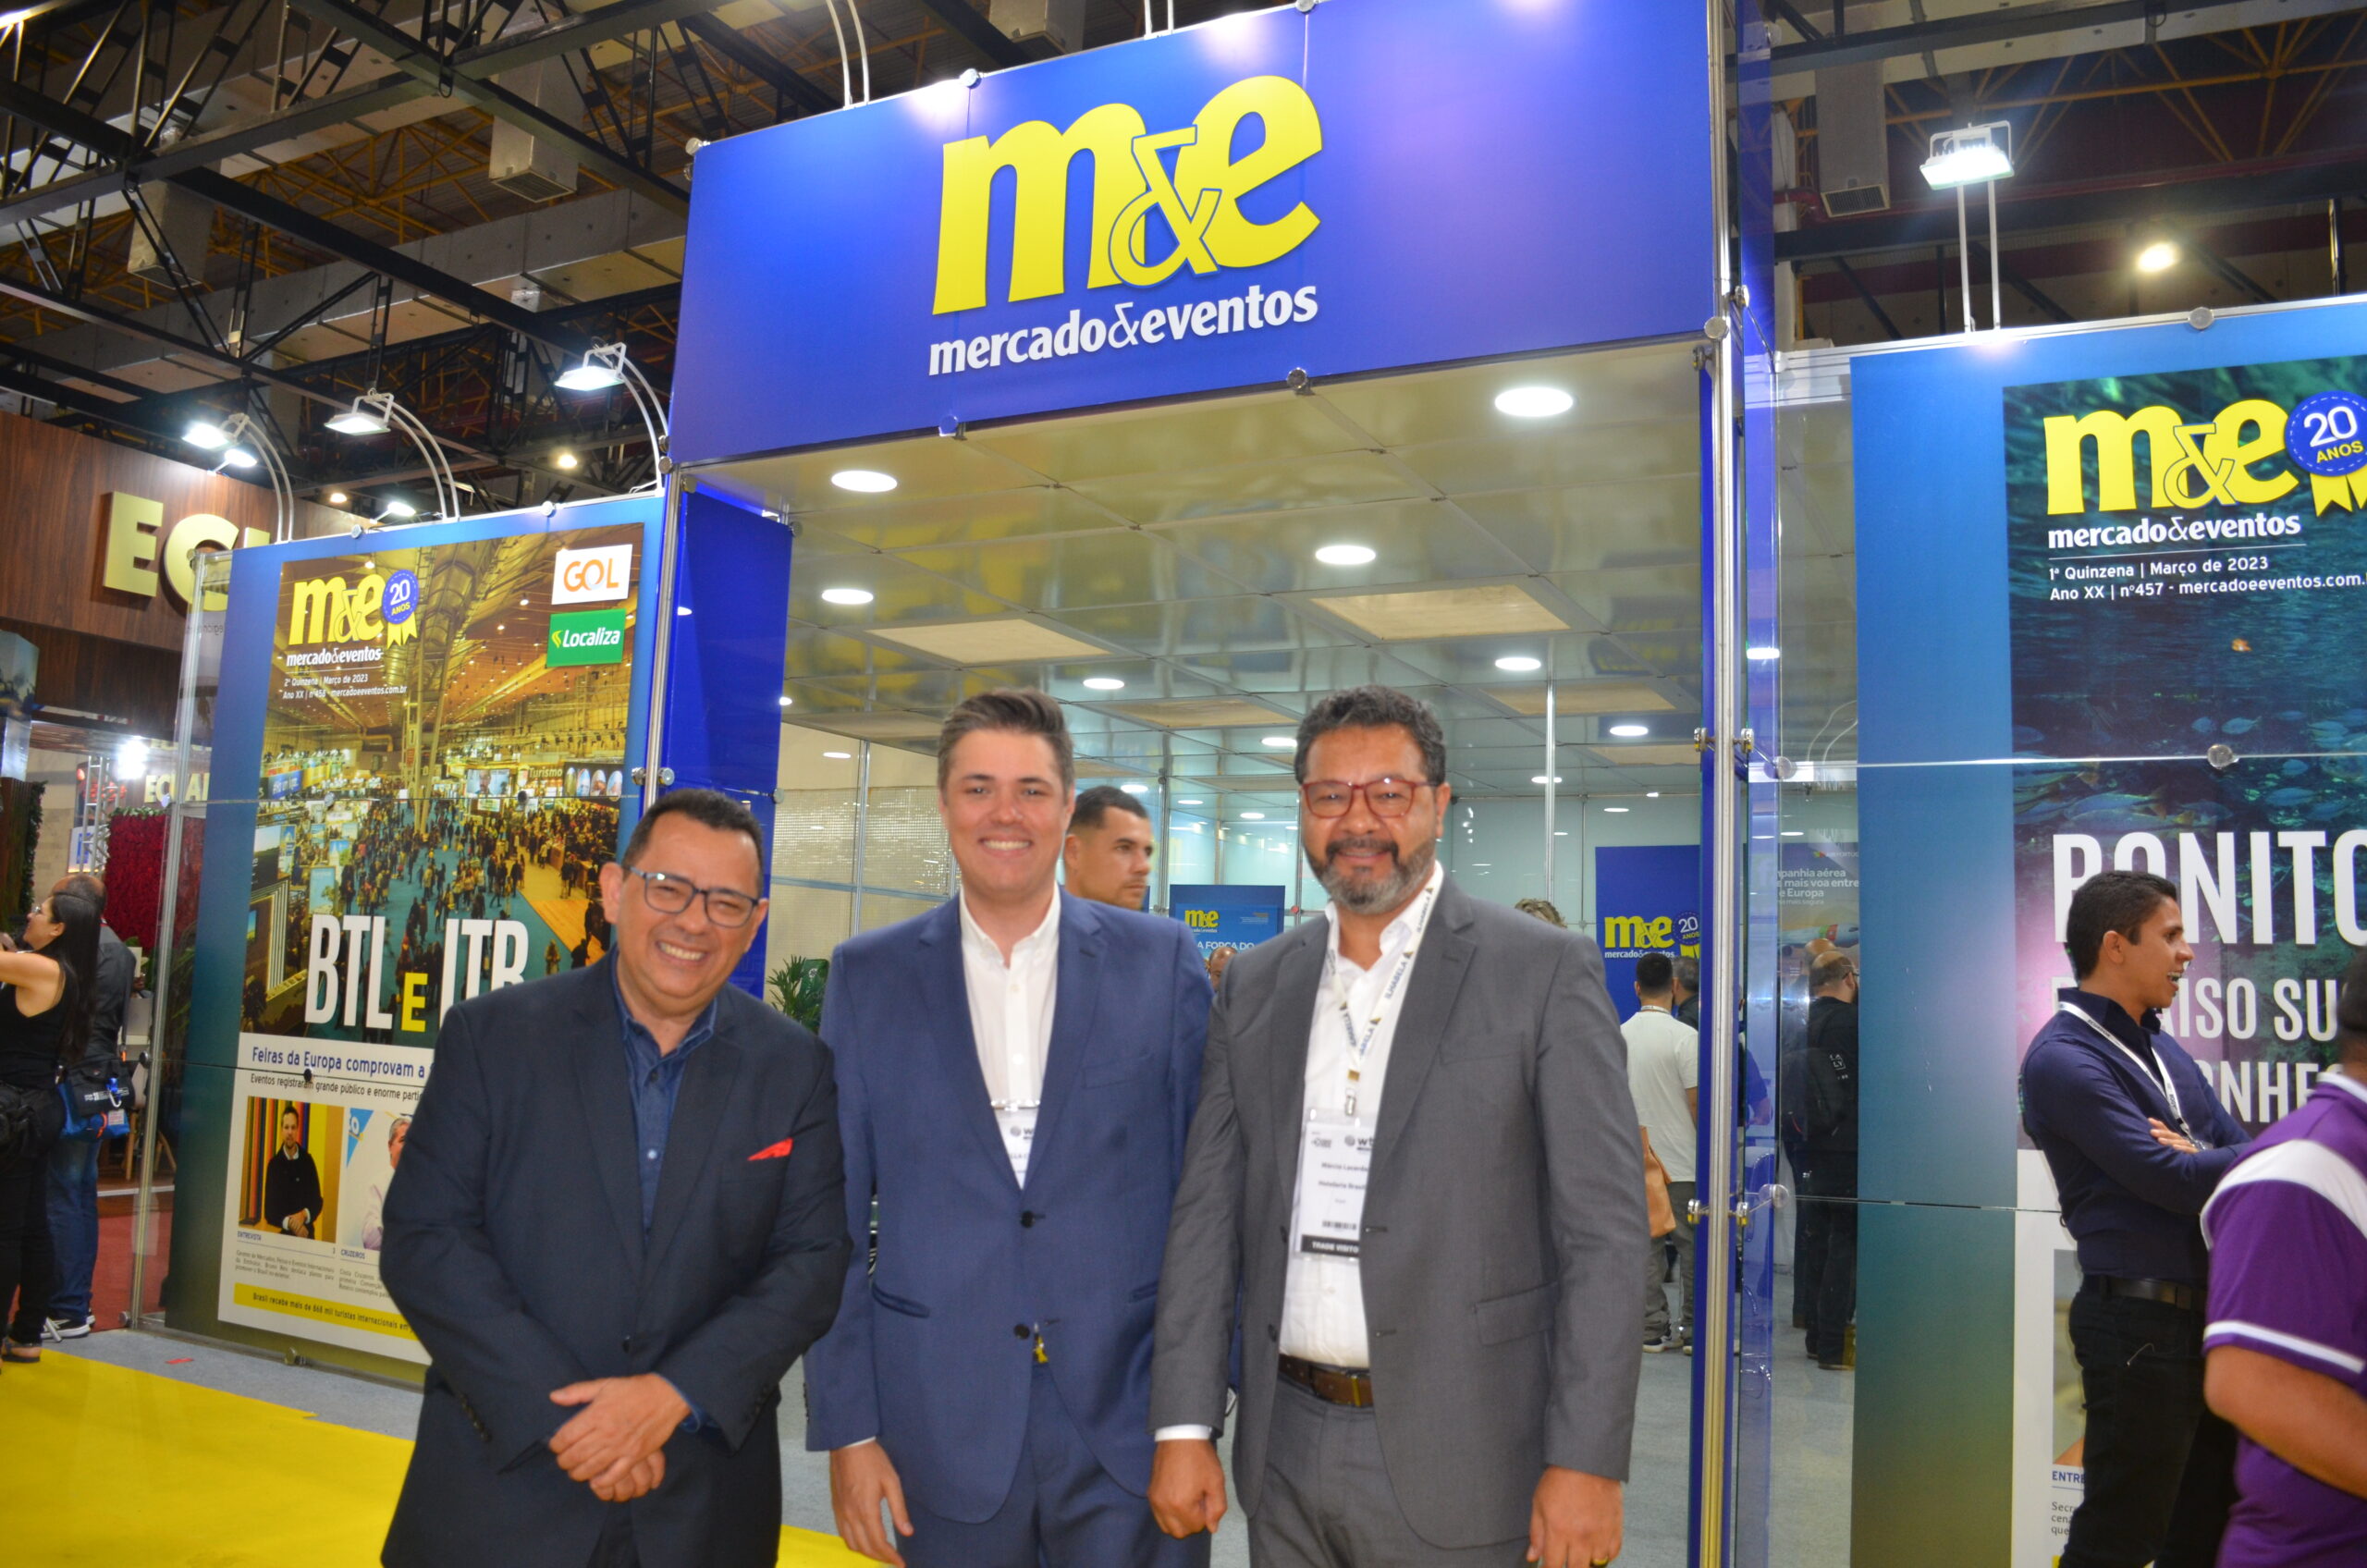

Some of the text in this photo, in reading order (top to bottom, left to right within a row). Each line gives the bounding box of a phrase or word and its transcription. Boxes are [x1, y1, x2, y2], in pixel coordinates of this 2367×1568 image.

[932, 75, 1323, 315] m&e
[928, 285, 1319, 376] mercado&eventos
[2303, 406, 2358, 447] 20
[2043, 399, 2300, 515] m&e
[2316, 440, 2365, 463] ANOS
[2048, 512, 2301, 549] mercado&eventos
[103, 491, 270, 611] EC
[563, 557, 619, 593] GOL
[2065, 564, 2135, 581] Quinzena
[2151, 560, 2197, 577] Março
[2202, 557, 2222, 572] de
[2227, 557, 2269, 571] 2023
[389, 579, 411, 606] 20
[2050, 587, 2080, 601] Ano
[2084, 585, 2105, 599] XX
[288, 573, 386, 645] m&e
[391, 601, 411, 616] ANOS
[562, 627, 621, 648] Localiza
[286, 646, 381, 667] mercado&eventos
[324, 675, 341, 686] Março
[343, 675, 351, 683] de
[352, 673, 369, 683] 2023
[282, 691, 294, 700] Ano
[295, 690, 304, 699] XX
[1784, 878, 1809, 888] mais
[1831, 878, 1859, 888] entre
[1787, 888, 1824, 899] Europa
[1604, 915, 1675, 949] m&e
[1678, 916, 1699, 933] 20
[304, 913, 393, 1030] BTL
[400, 972, 428, 1033] E
[252, 1047, 424, 1078] Feiras da Europa comprovam a
[251, 1072, 276, 1085] Eventos
[276, 1076, 313, 1090] registraram
[315, 1081, 338, 1095] grande
[340, 1083, 365, 1097] público
[367, 1087, 372, 1096] e
[374, 1088, 400, 1100] enorme
[253, 1292, 268, 1302] Brasil
[269, 1294, 288, 1306] recebe
[289, 1298, 302, 1309] mais
[304, 1303, 312, 1312] de
[325, 1307, 334, 1317] mil
[335, 1308, 356, 1321] turistas
[357, 1312, 398, 1329] internacionais
